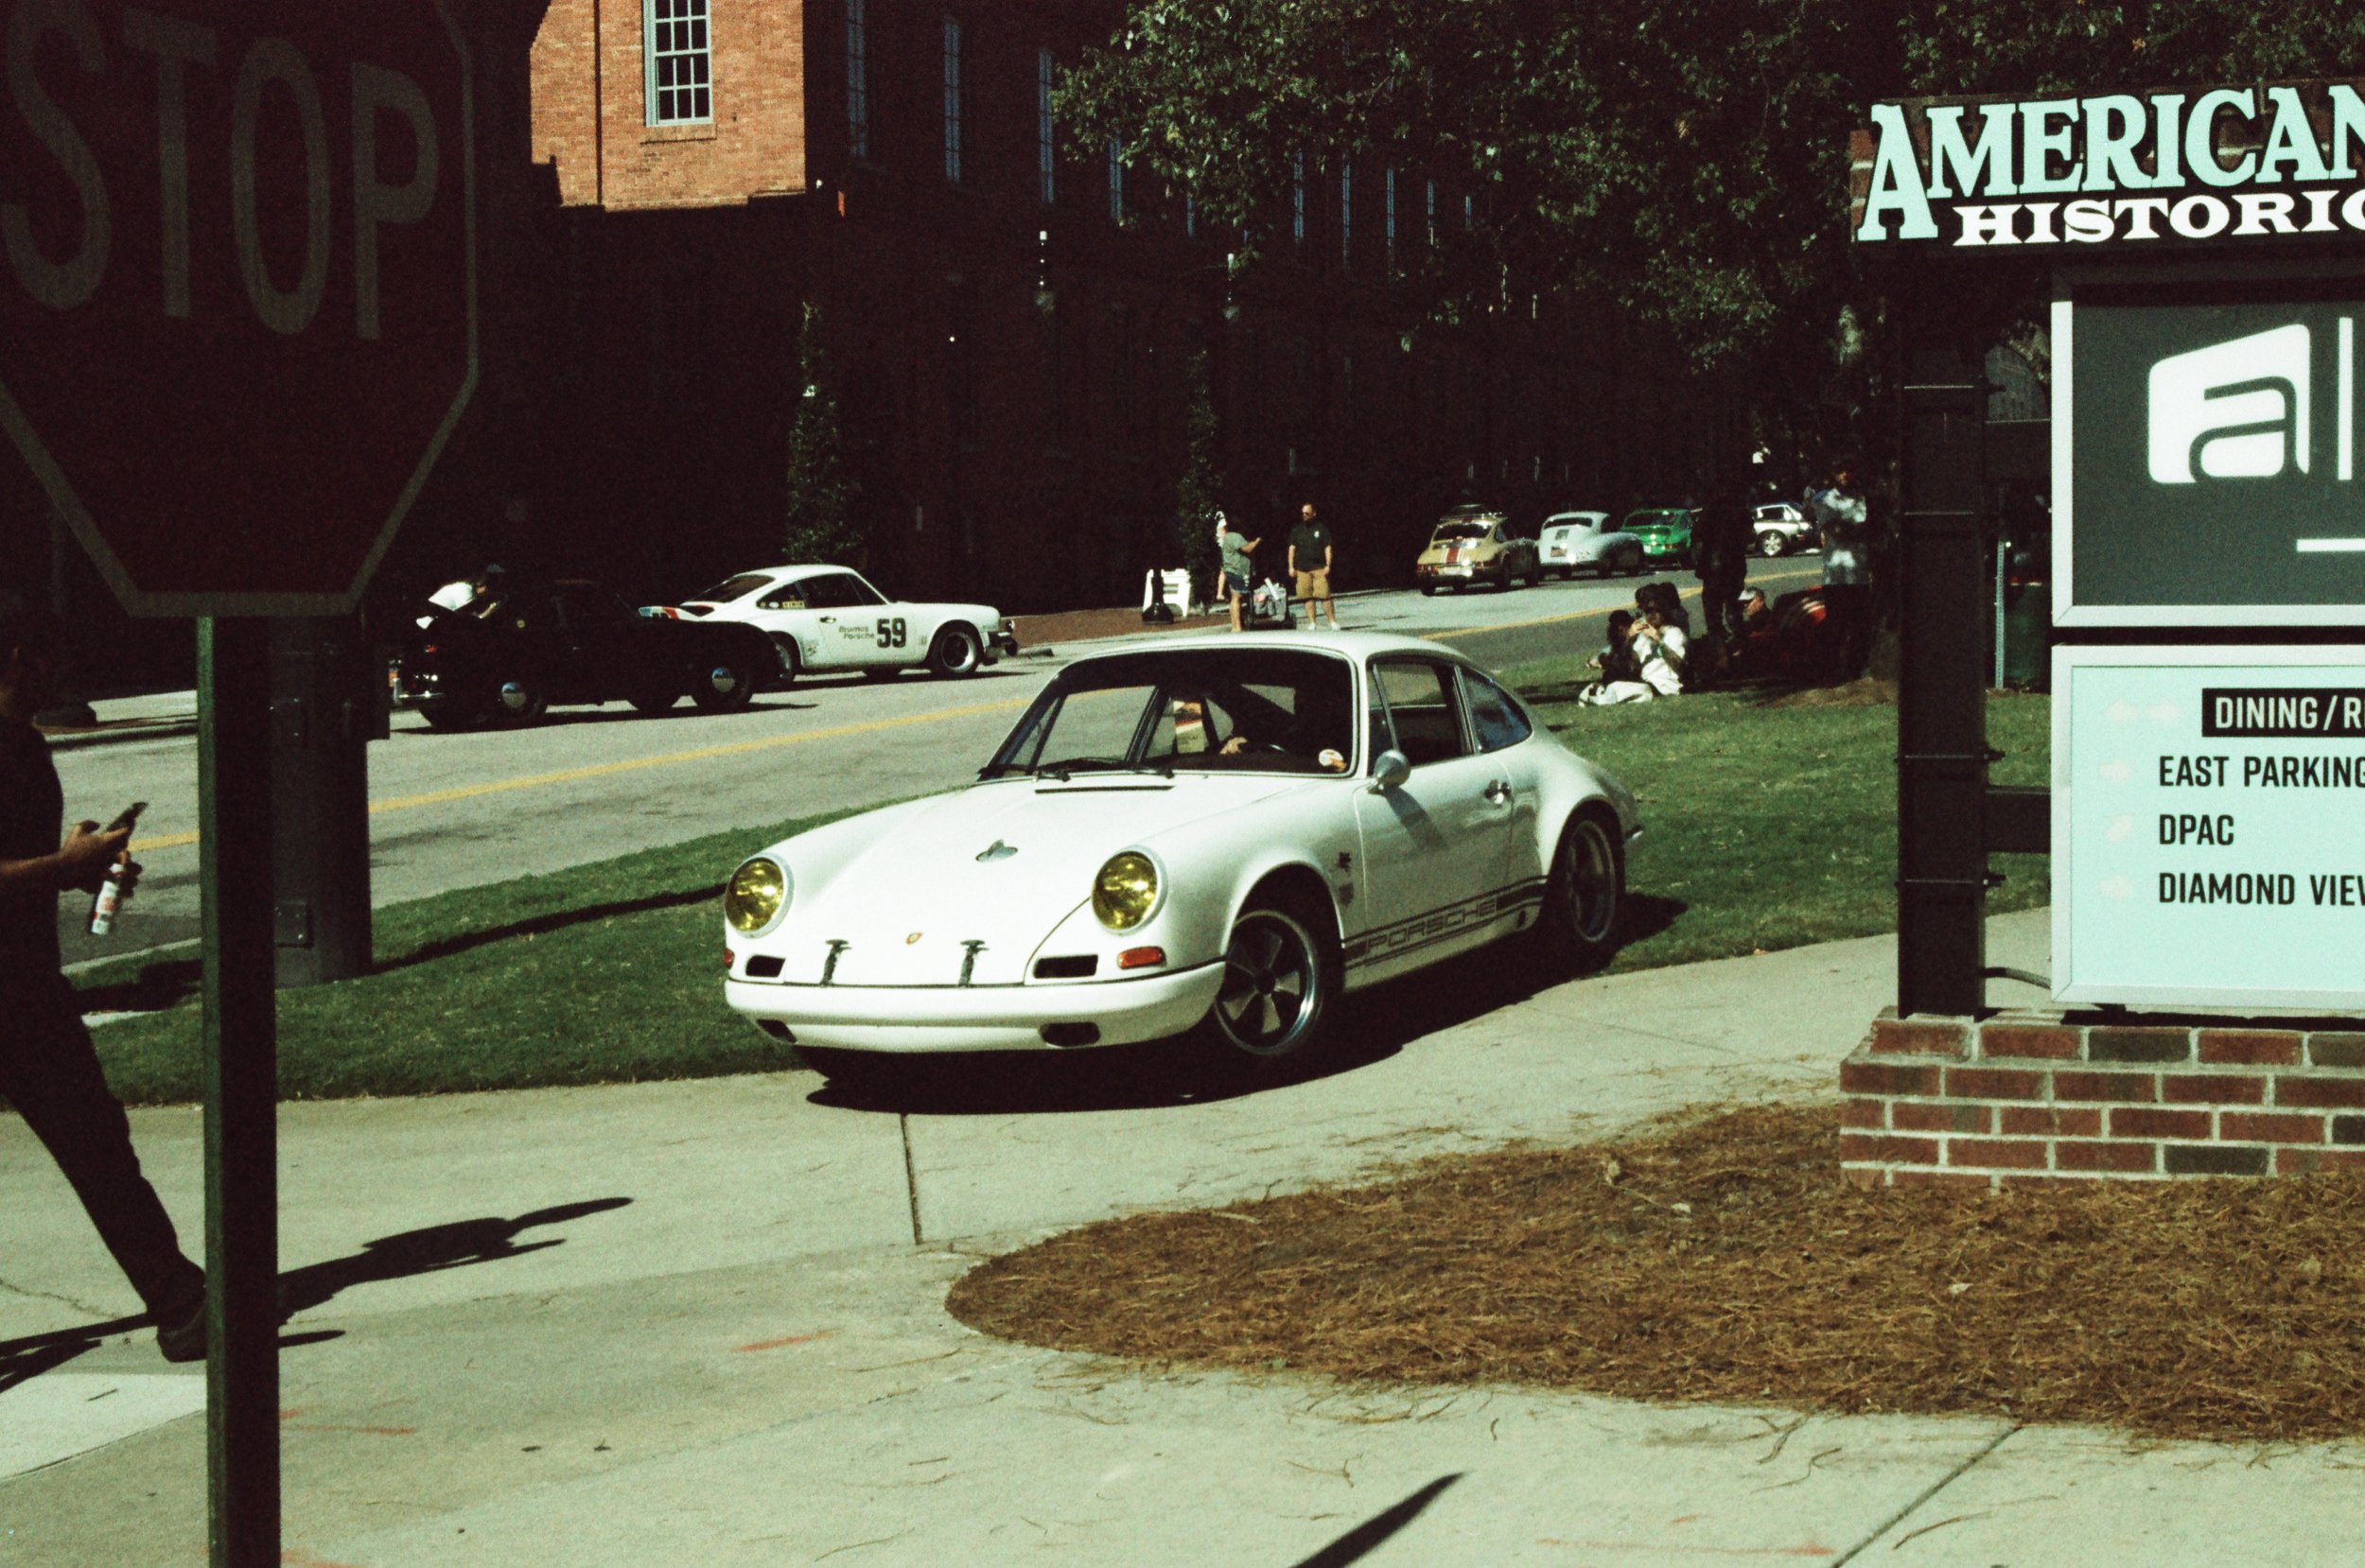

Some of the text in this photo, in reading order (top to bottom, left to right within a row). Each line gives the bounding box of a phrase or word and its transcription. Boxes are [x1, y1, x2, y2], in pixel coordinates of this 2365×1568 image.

[2, 0, 439, 340] STOP
[876, 618, 906, 648] 59
[2216, 694, 2365, 730] DINING/R
[2160, 756, 2230, 787] EAST
[2160, 814, 2234, 846] DPAC
[2160, 873, 2295, 905] DIAMOND
[1366, 898, 1498, 954] PORSCHE
